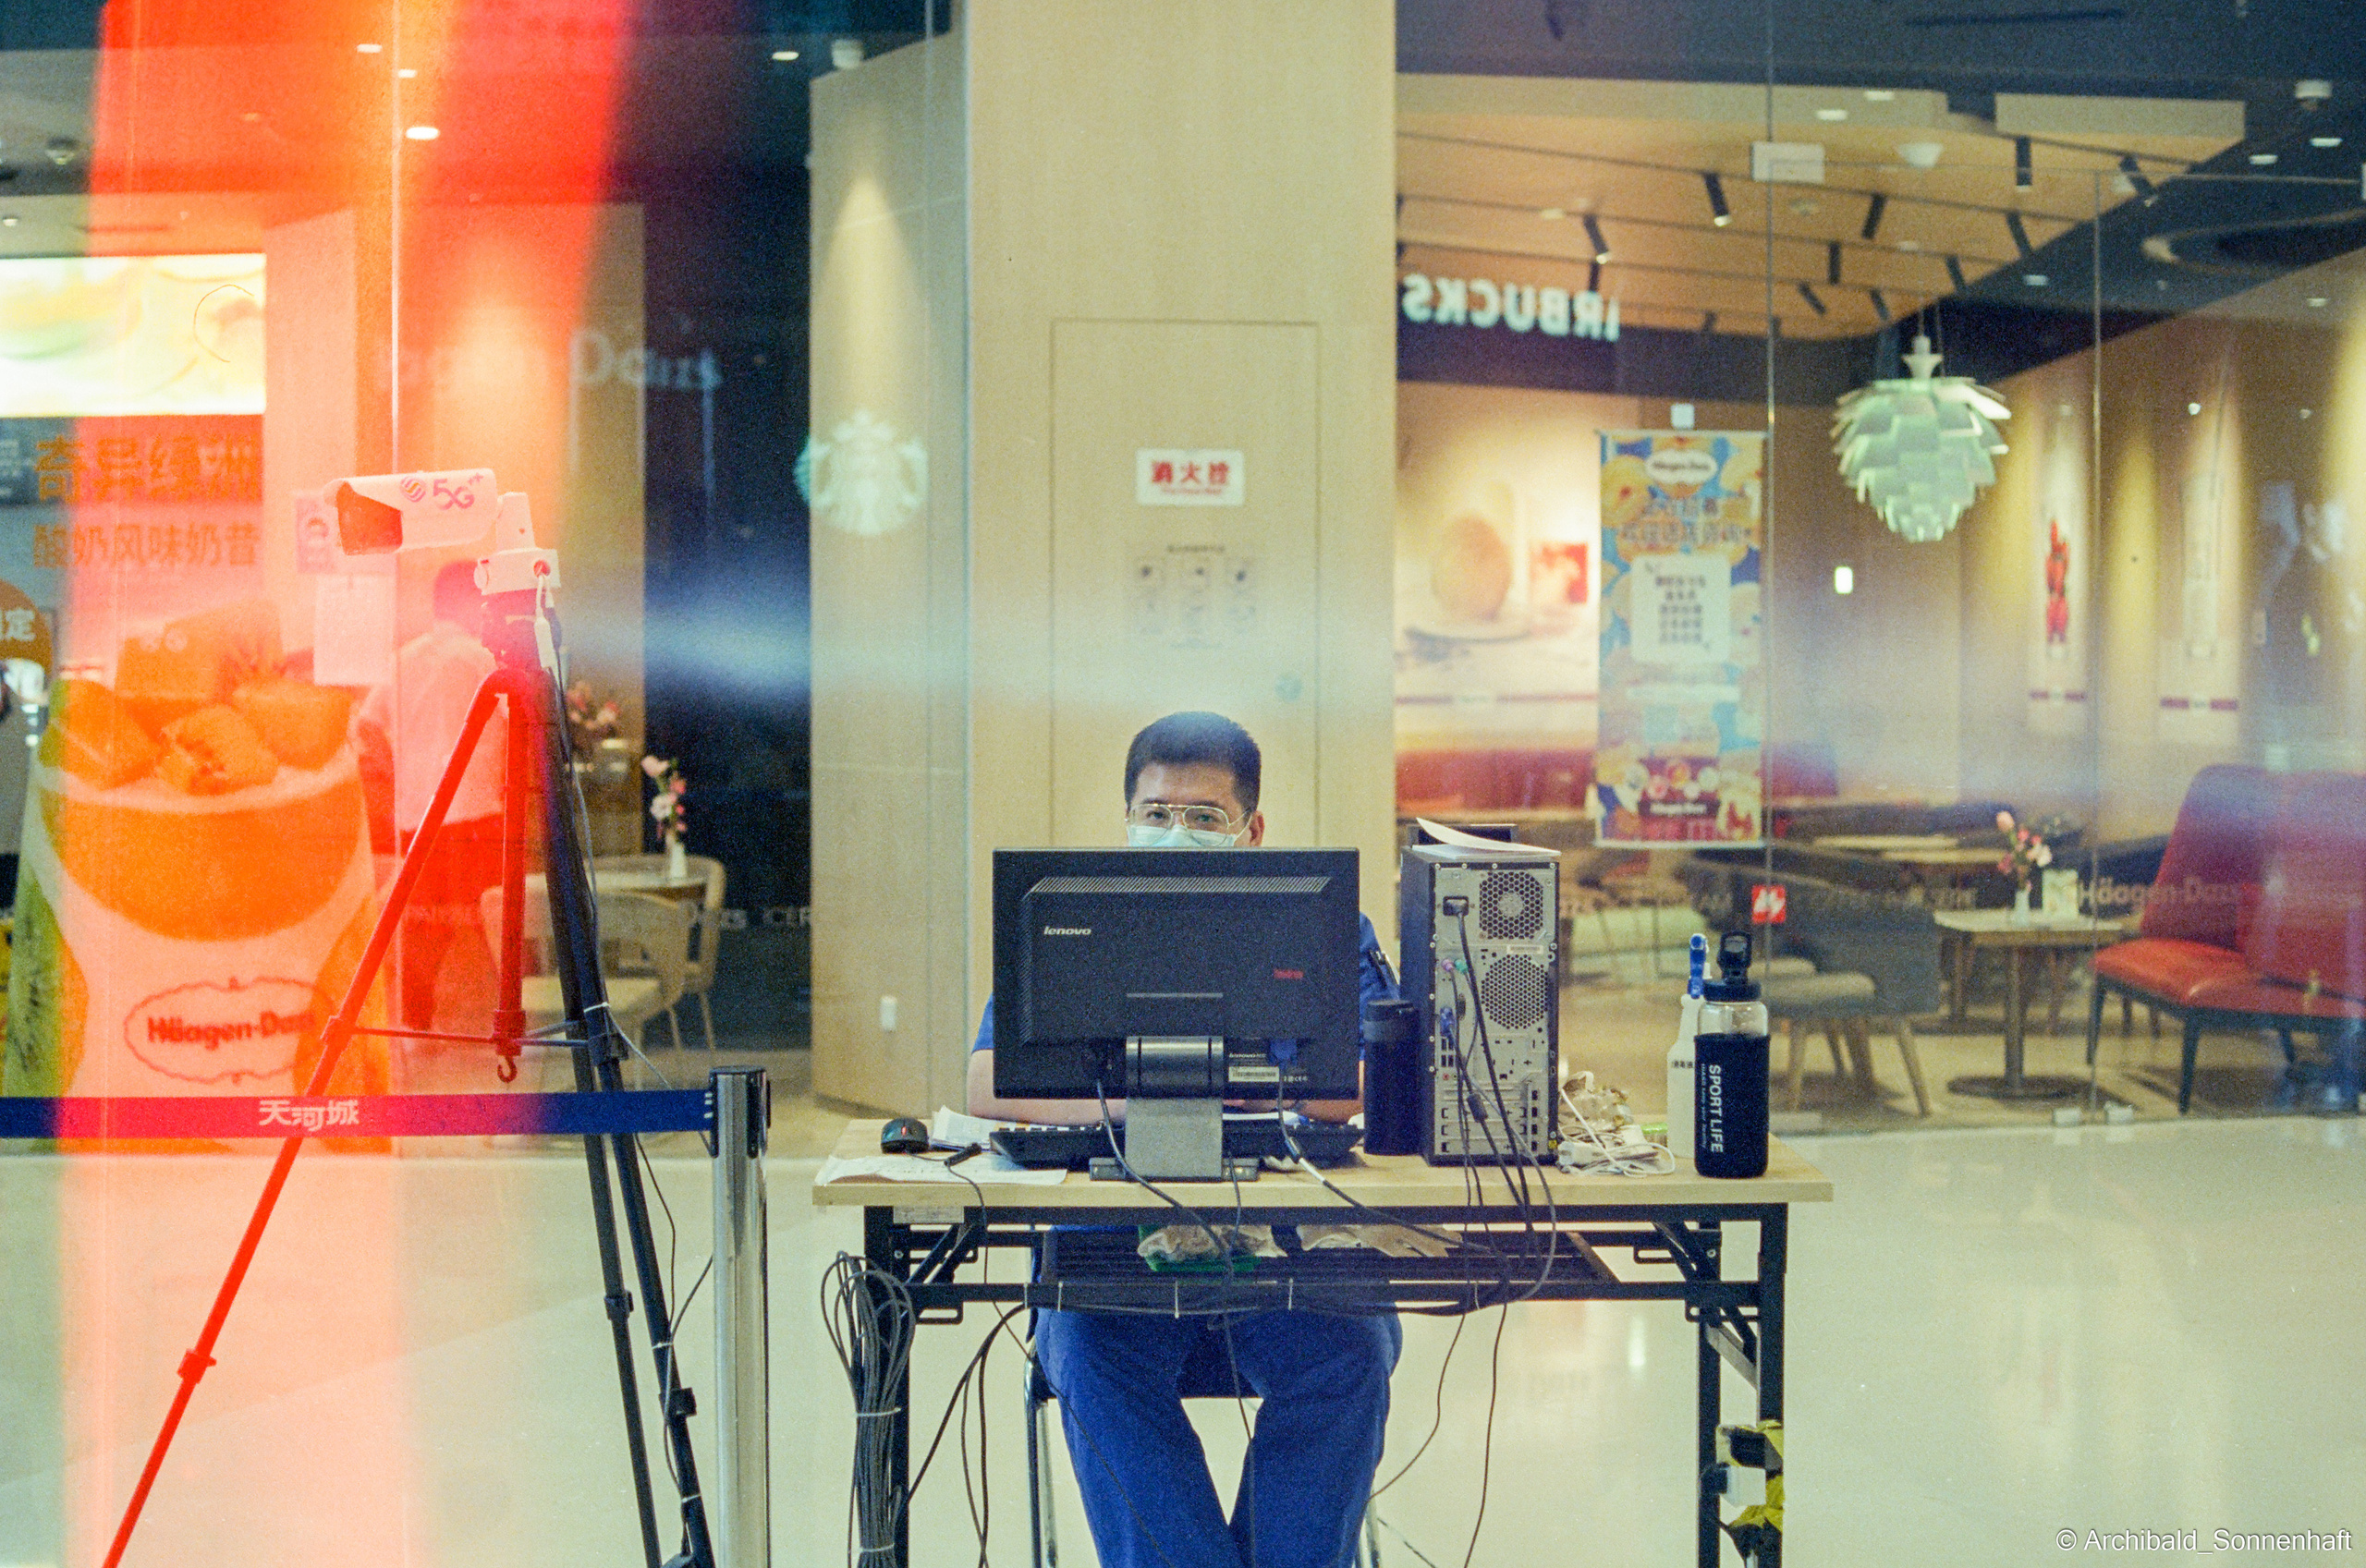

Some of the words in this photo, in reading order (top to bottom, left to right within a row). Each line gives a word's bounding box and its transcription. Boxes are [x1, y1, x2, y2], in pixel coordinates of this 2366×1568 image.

[33, 521, 260, 569] 酸奶风味奶昔
[1043, 925, 1092, 935] lenovo
[1708, 1064, 1723, 1118] SPORT
[259, 1100, 360, 1132] 天河城
[1710, 1119, 1724, 1153] LIFE
